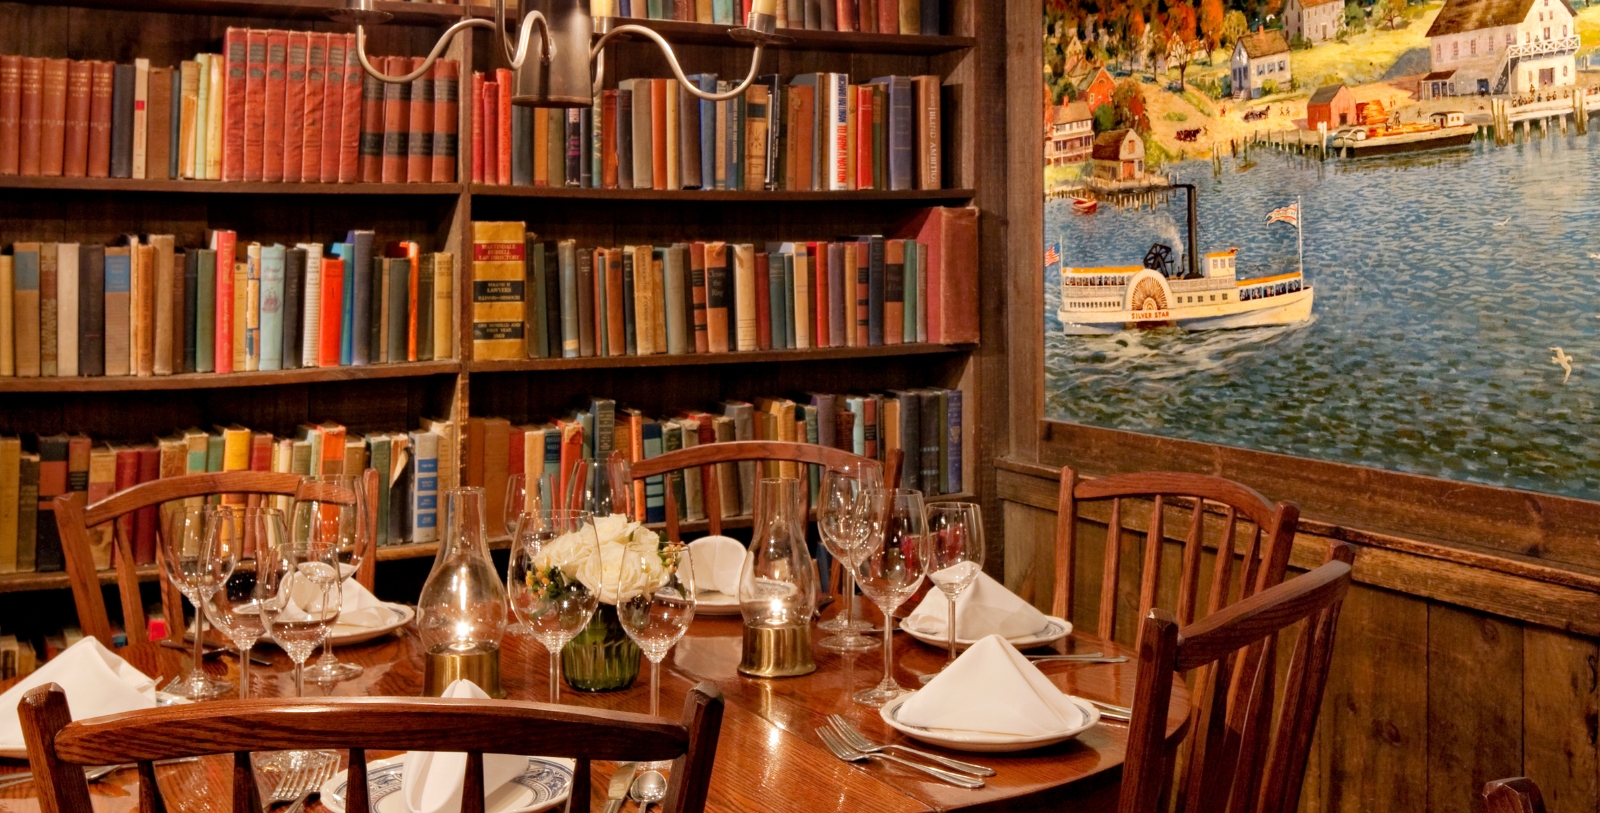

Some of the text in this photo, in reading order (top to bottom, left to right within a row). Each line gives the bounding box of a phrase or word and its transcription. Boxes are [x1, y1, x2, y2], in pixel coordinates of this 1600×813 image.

[837, 125, 847, 133] TO
[837, 134, 847, 150] ARM
[929, 111, 938, 186] BLIND AMBITION
[837, 158, 847, 183] NATION
